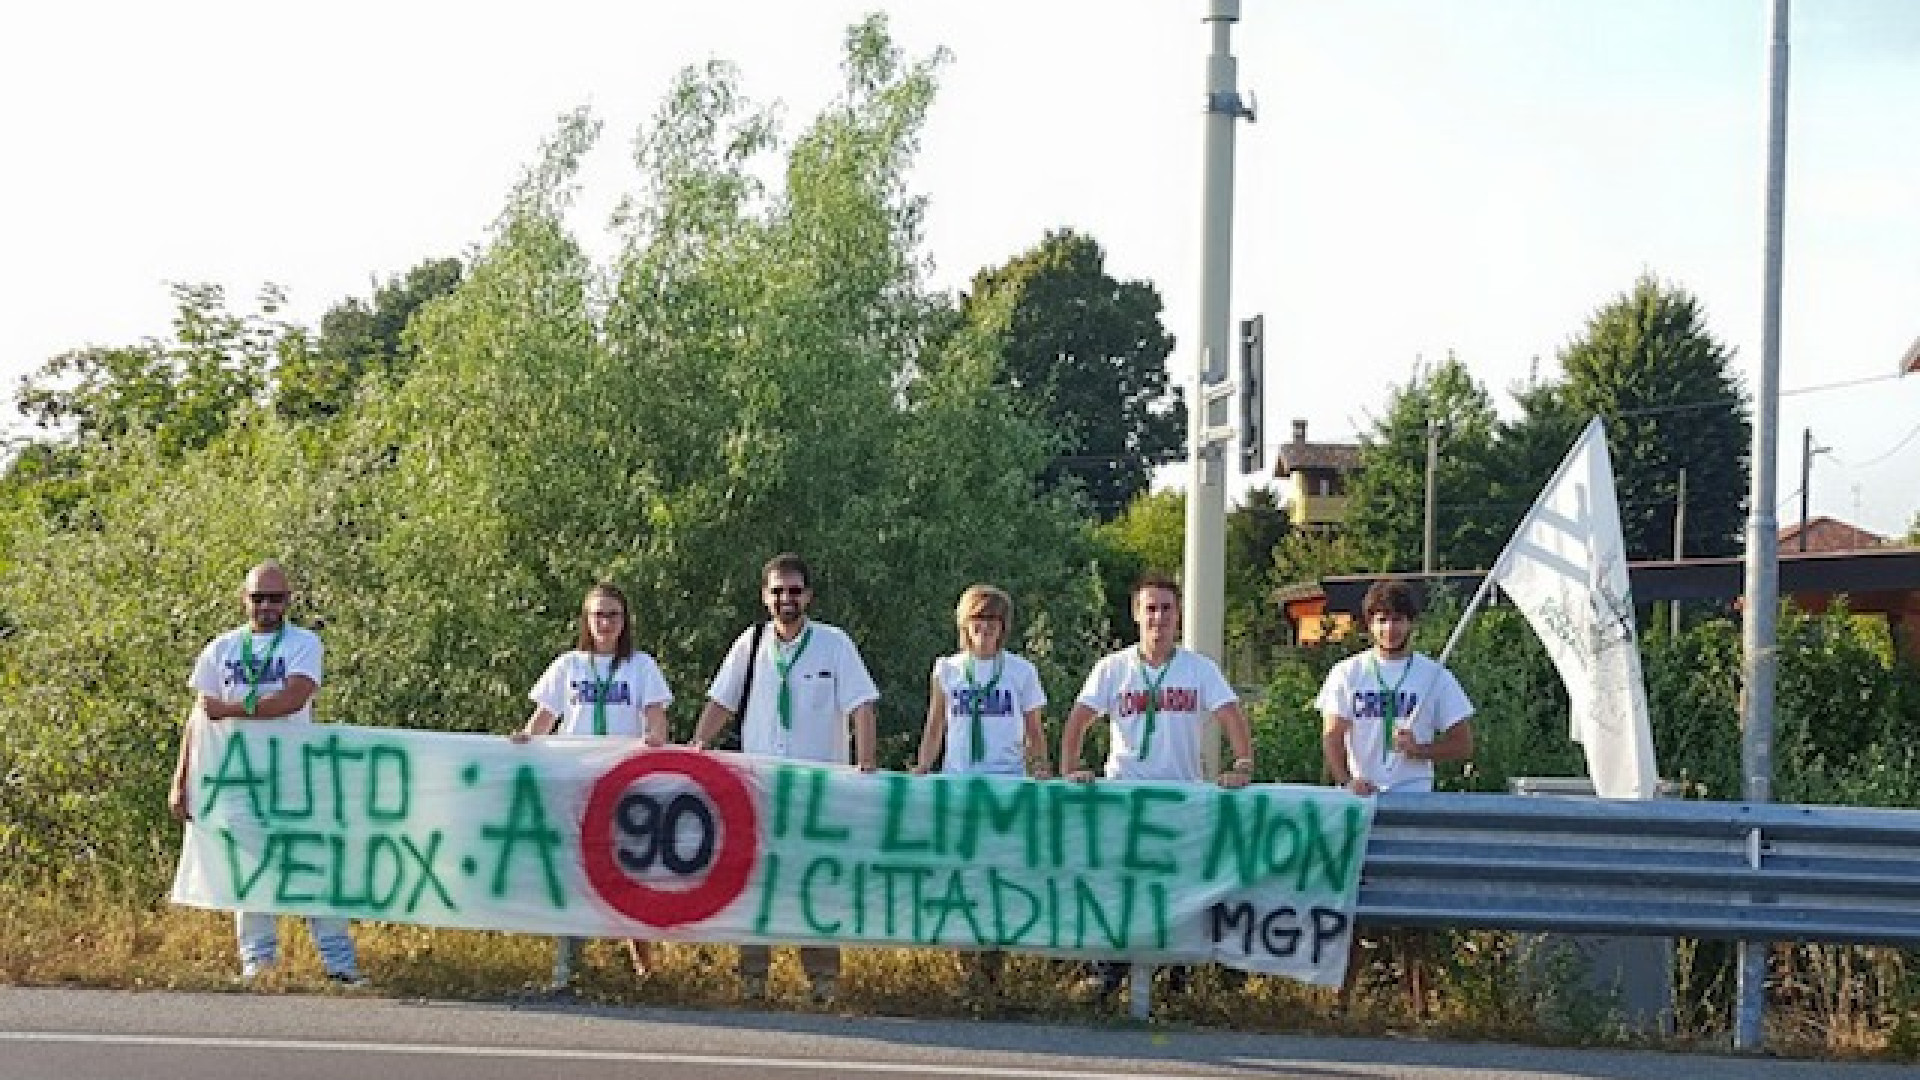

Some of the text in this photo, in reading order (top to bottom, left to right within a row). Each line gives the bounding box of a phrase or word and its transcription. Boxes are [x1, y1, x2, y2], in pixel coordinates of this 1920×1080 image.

[201, 729, 410, 827] AUTO
[219, 829, 455, 911] VELOX
[613, 790, 718, 877] 90
[770, 766, 1362, 892] IL LIMITE NON
[754, 854, 1169, 951] I CITTADINI
[1210, 900, 1348, 964] MGP
